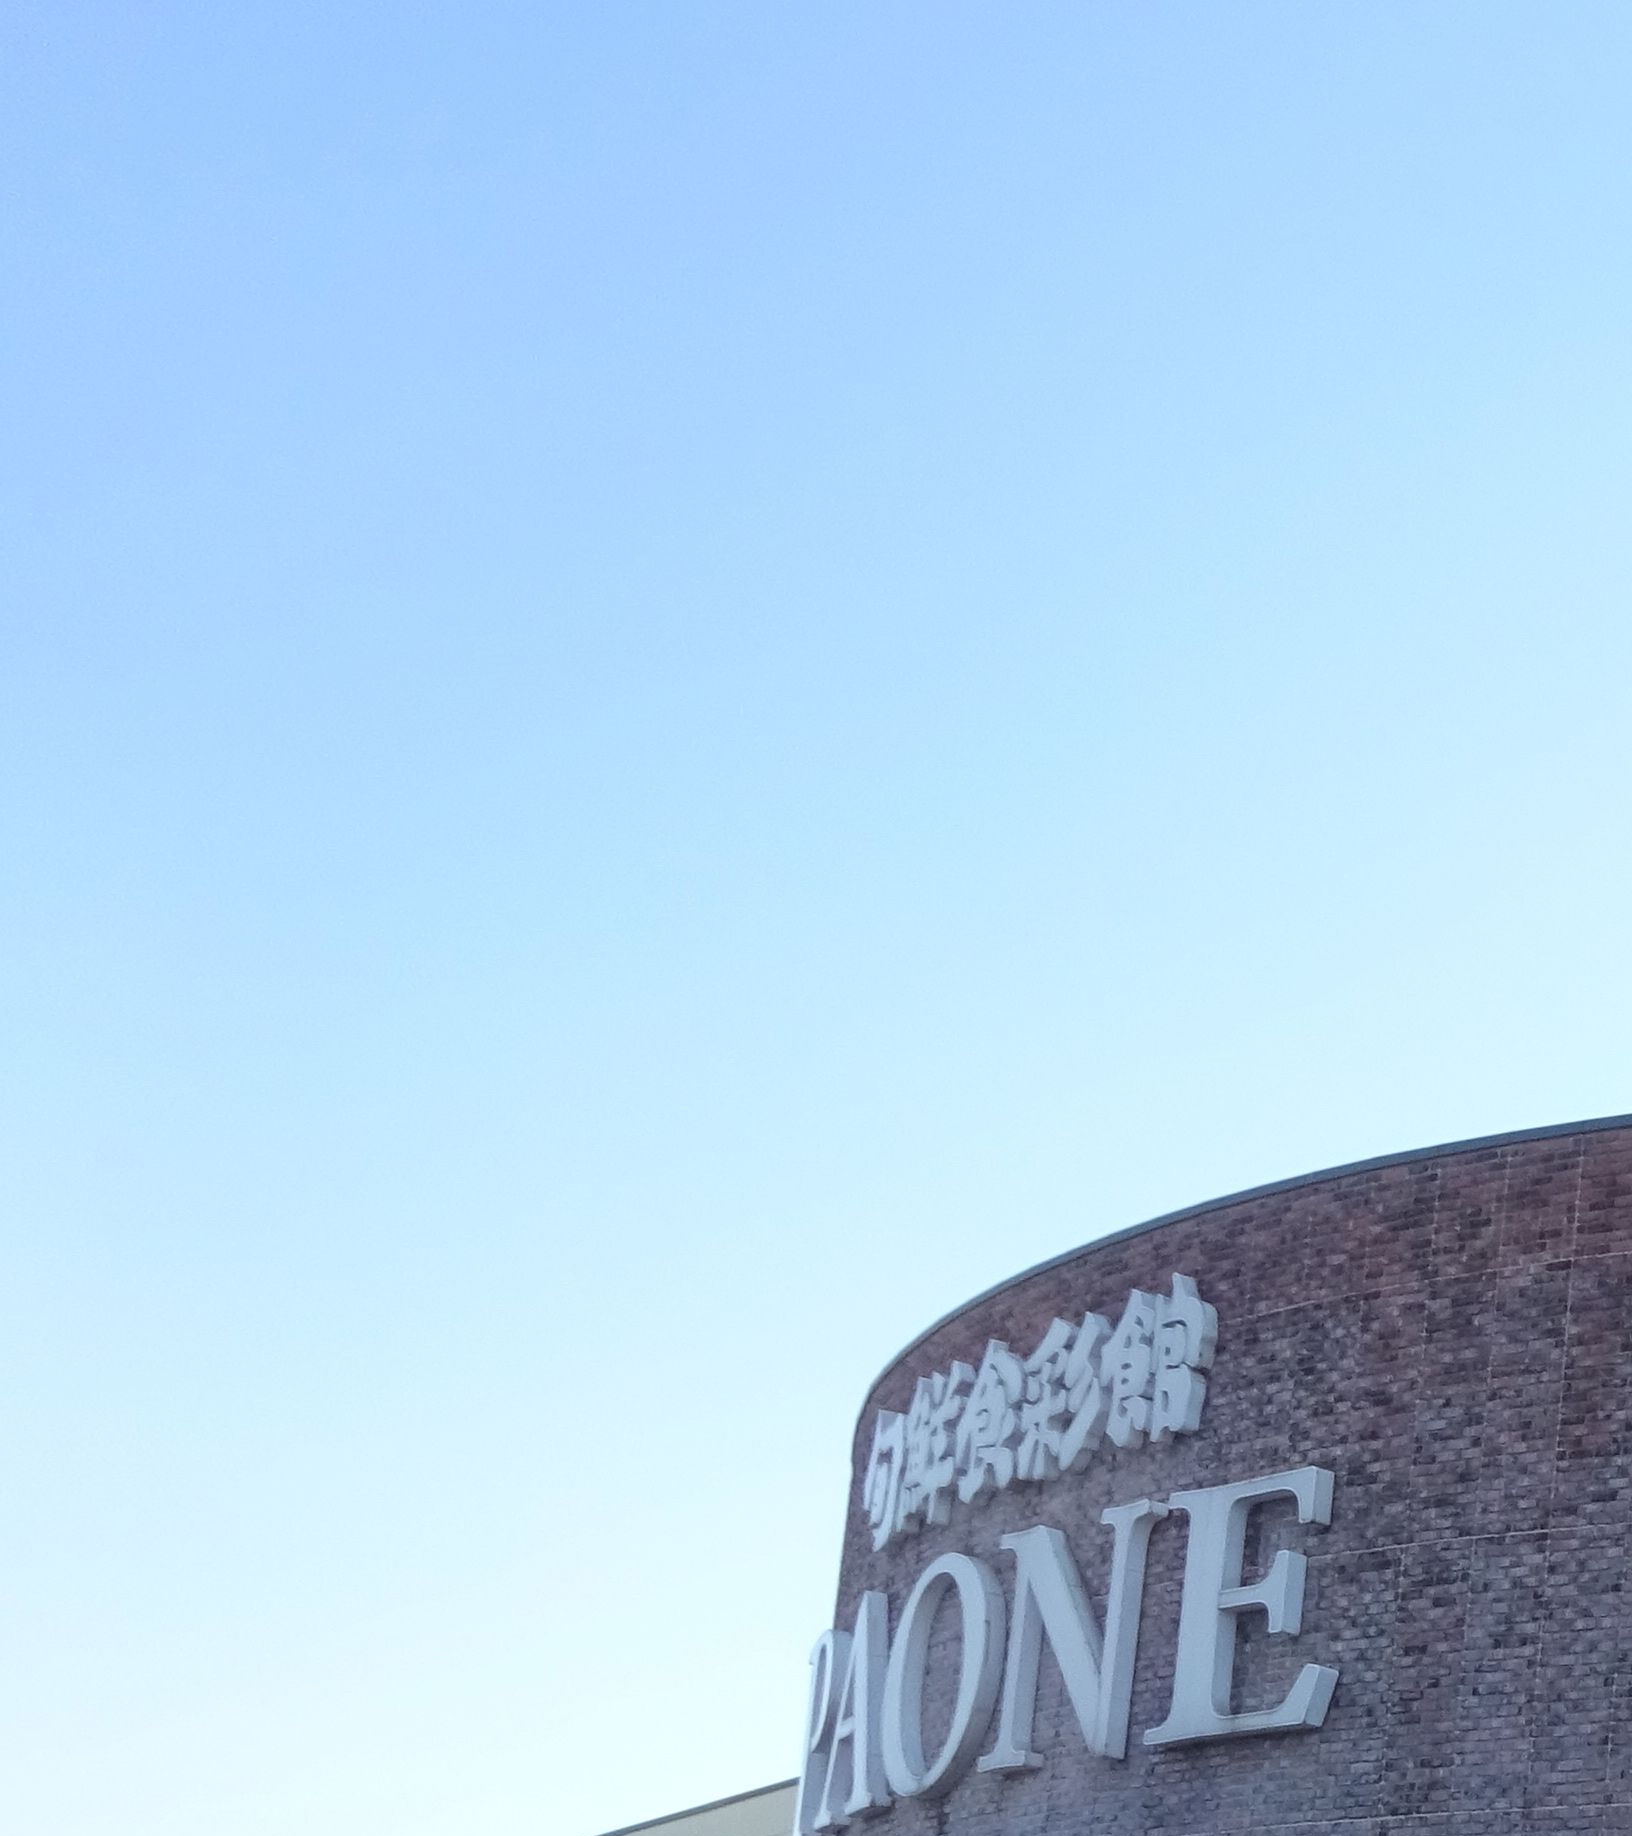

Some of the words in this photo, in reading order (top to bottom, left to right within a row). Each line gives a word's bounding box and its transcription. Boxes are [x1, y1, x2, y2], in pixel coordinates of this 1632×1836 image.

[864, 1271, 1218, 1551] 旬鮮食彩館
